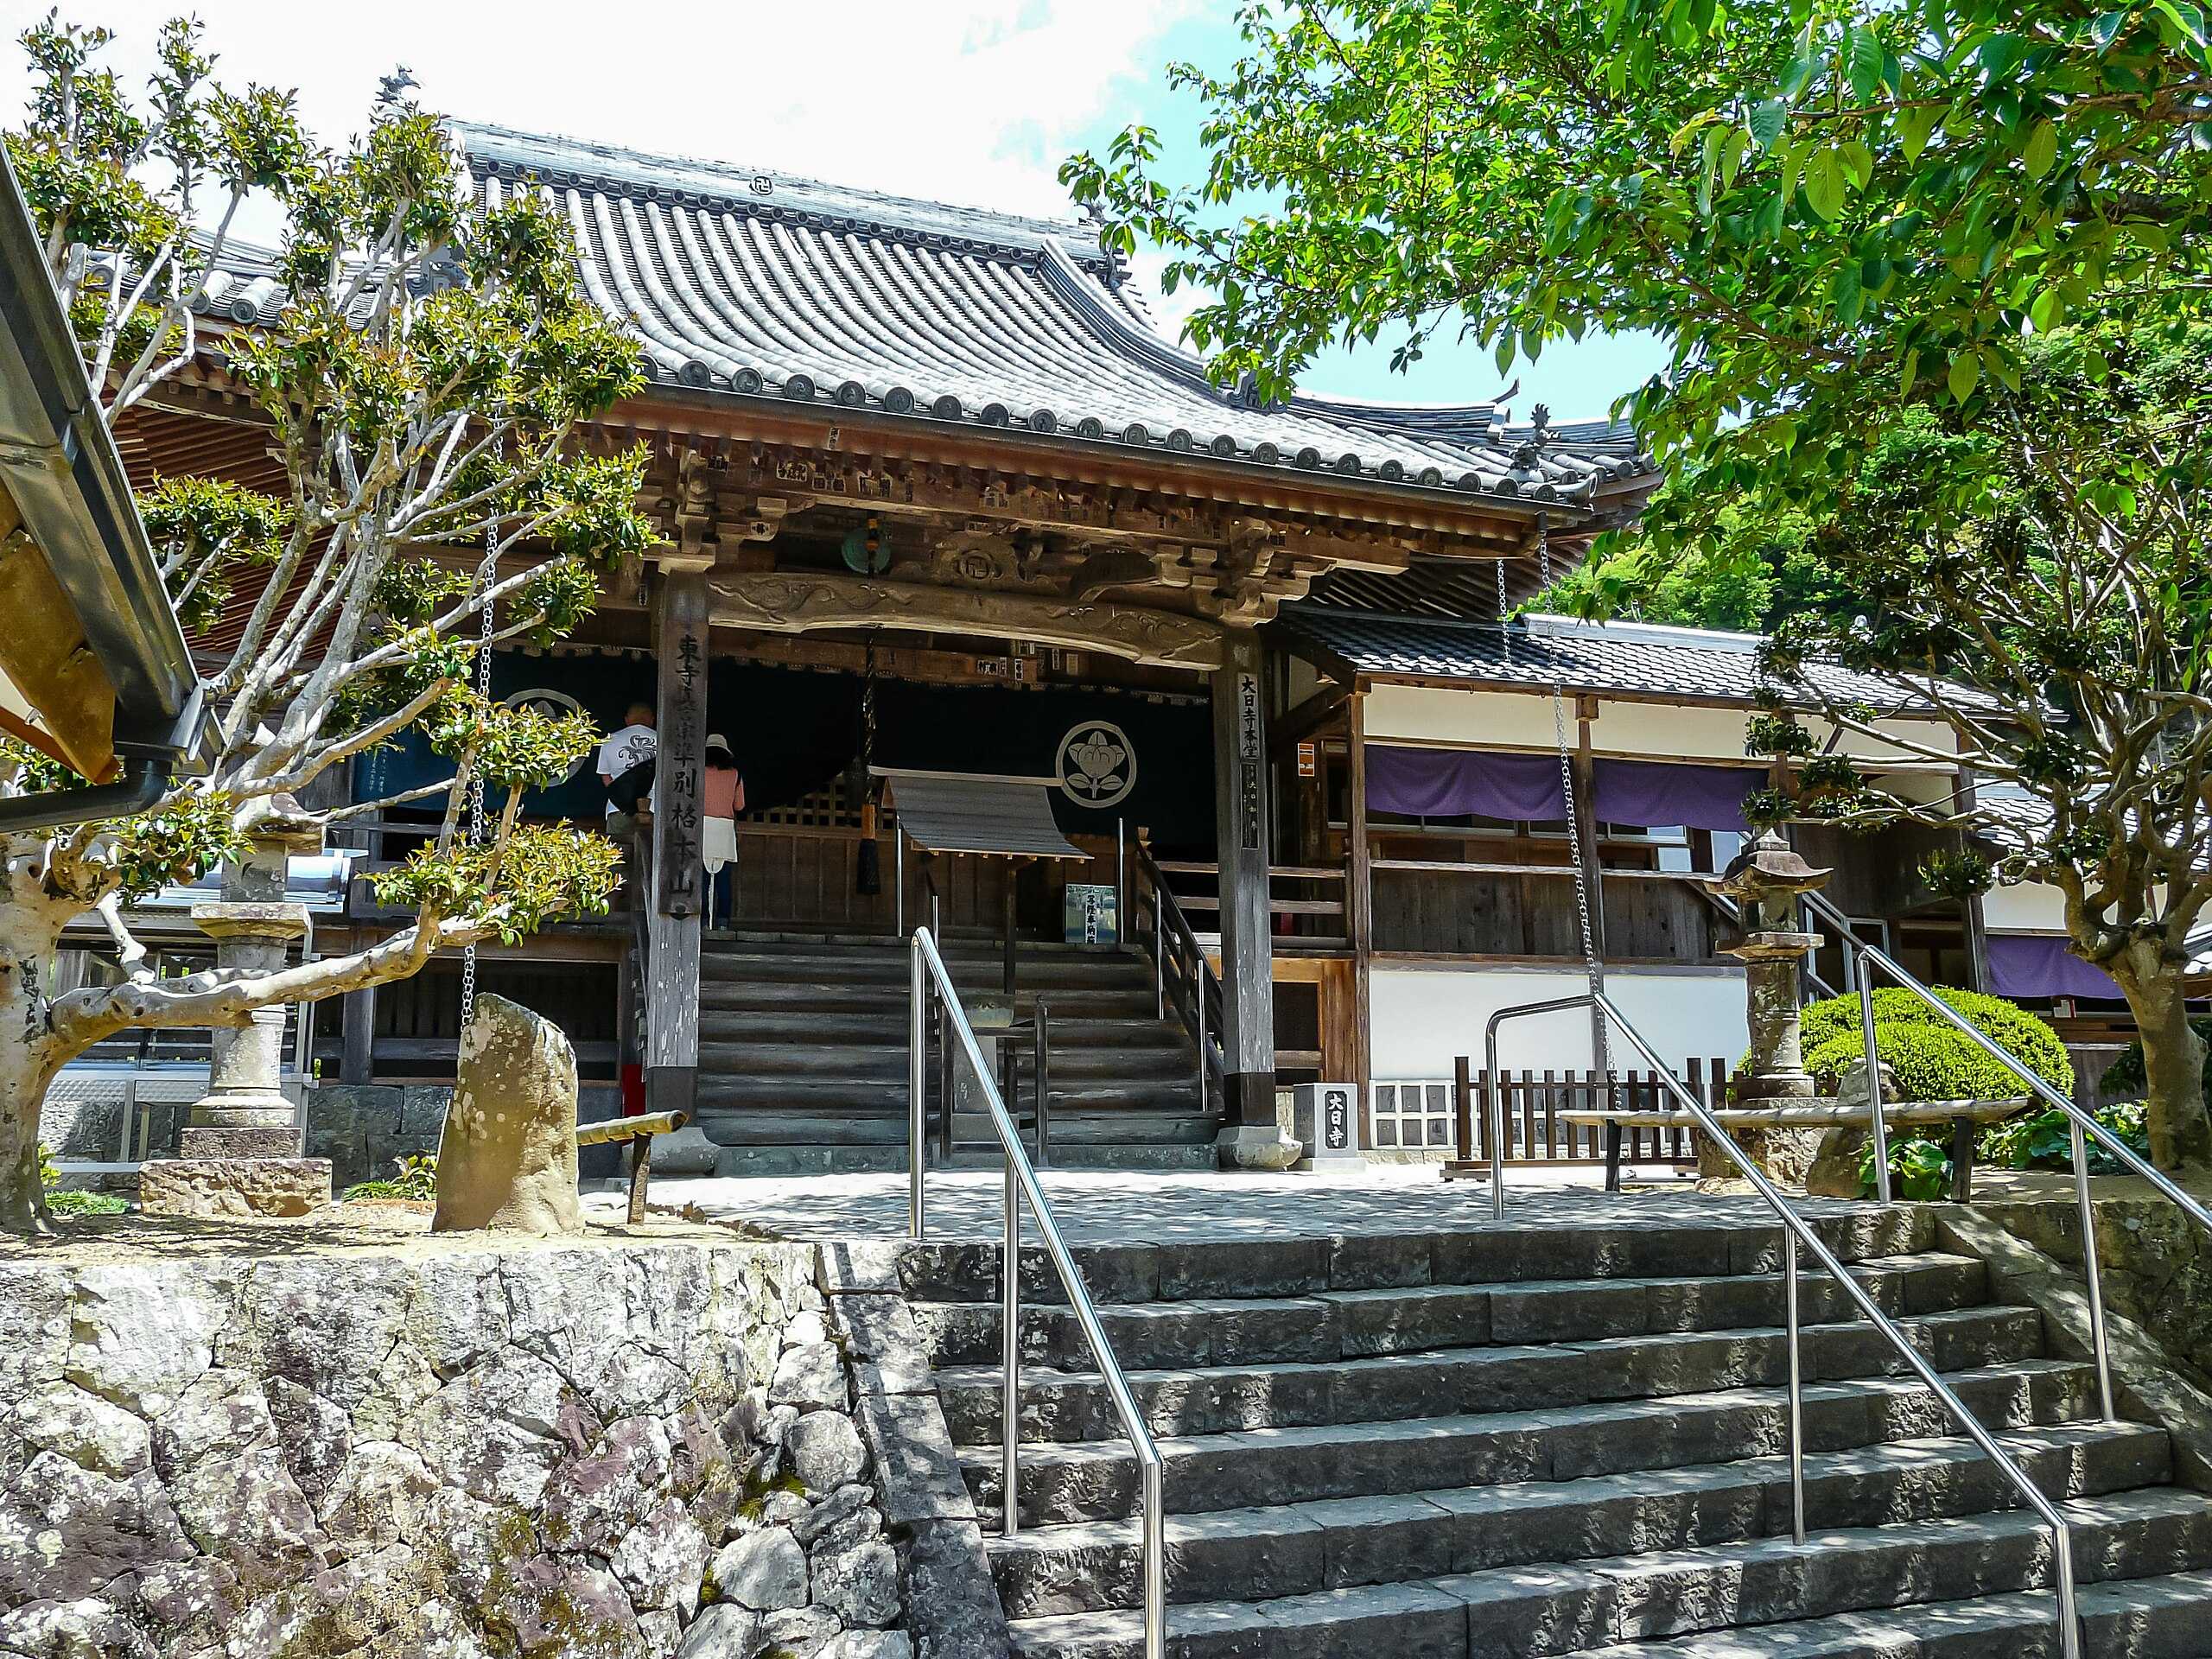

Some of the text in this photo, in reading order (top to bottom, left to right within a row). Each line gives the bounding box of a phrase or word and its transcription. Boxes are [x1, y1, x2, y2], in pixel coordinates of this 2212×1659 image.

[1242, 676, 1258, 758] 大日寺本堂
[1328, 1094, 1344, 1147] 大日寺
